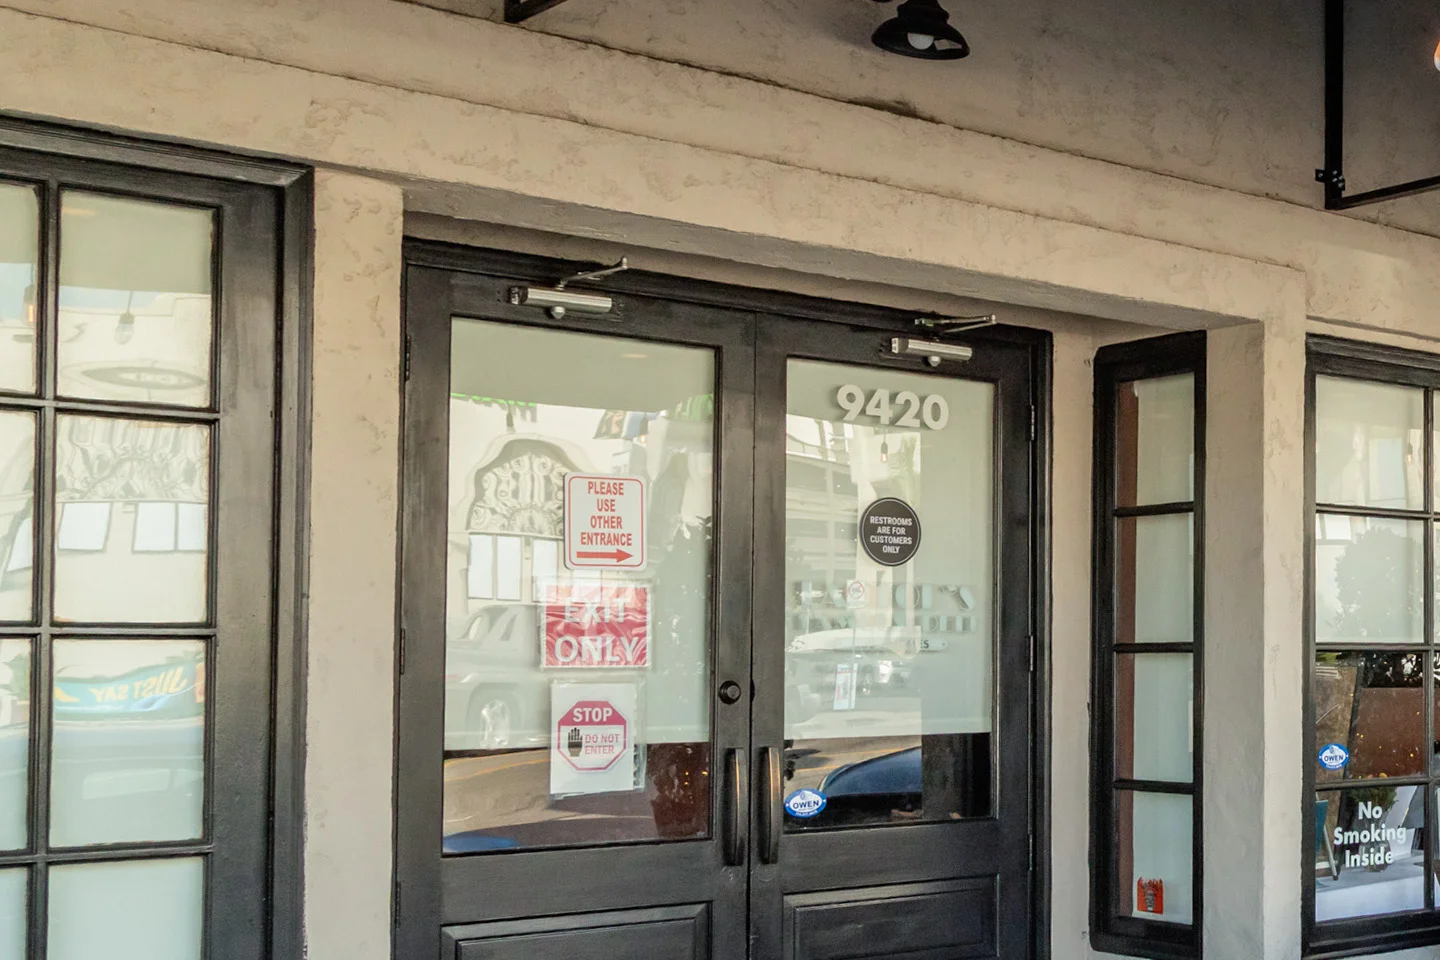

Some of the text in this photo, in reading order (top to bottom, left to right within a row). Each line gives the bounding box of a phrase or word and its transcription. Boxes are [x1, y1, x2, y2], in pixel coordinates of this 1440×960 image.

[836, 383, 949, 431] 9420
[587, 481, 624, 496] PLEASE
[596, 498, 616, 513] USE
[589, 515, 622, 529] OTHER
[869, 516, 913, 526] RESTROOMS
[877, 526, 906, 535] ARE FOR
[580, 532, 632, 546] ENTRANCE
[869, 535, 913, 545] CUSTOMERS
[882, 545, 900, 554] ONLY
[563, 596, 631, 624] EXIT
[554, 635, 639, 663] ONLY
[572, 707, 613, 722] STOP
[584, 733, 620, 744] DO NOT
[584, 745, 615, 754] ENTER
[792, 800, 819, 809] OWEN
[1358, 801, 1382, 820] No
[1333, 823, 1407, 845] Smoking
[1345, 847, 1394, 868] Inside
